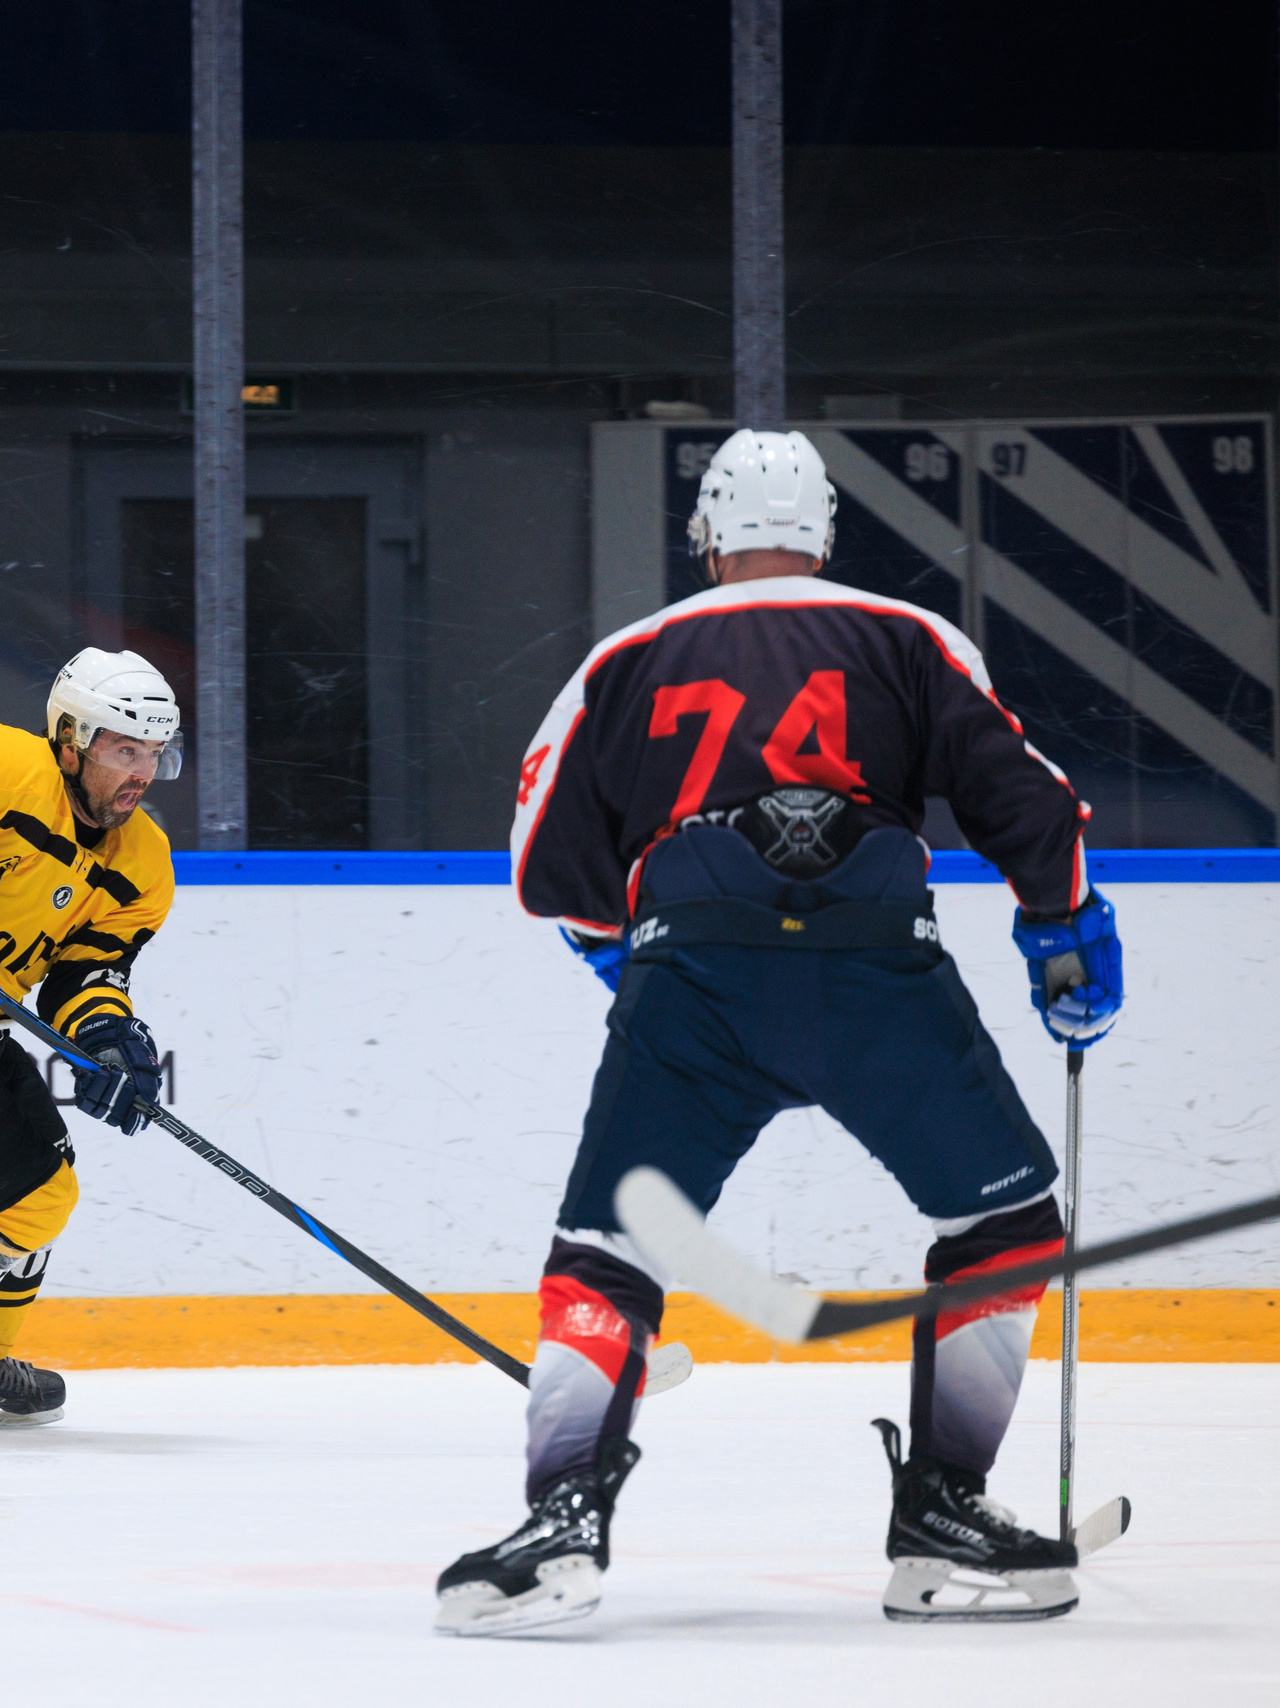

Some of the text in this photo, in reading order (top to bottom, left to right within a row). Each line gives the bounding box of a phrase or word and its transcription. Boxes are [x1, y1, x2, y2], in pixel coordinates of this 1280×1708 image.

[905, 443, 949, 481] 96
[992, 443, 1027, 478] 97
[1212, 436, 1253, 474] 98
[146, 716, 174, 724] CCM
[647, 669, 872, 834] 74
